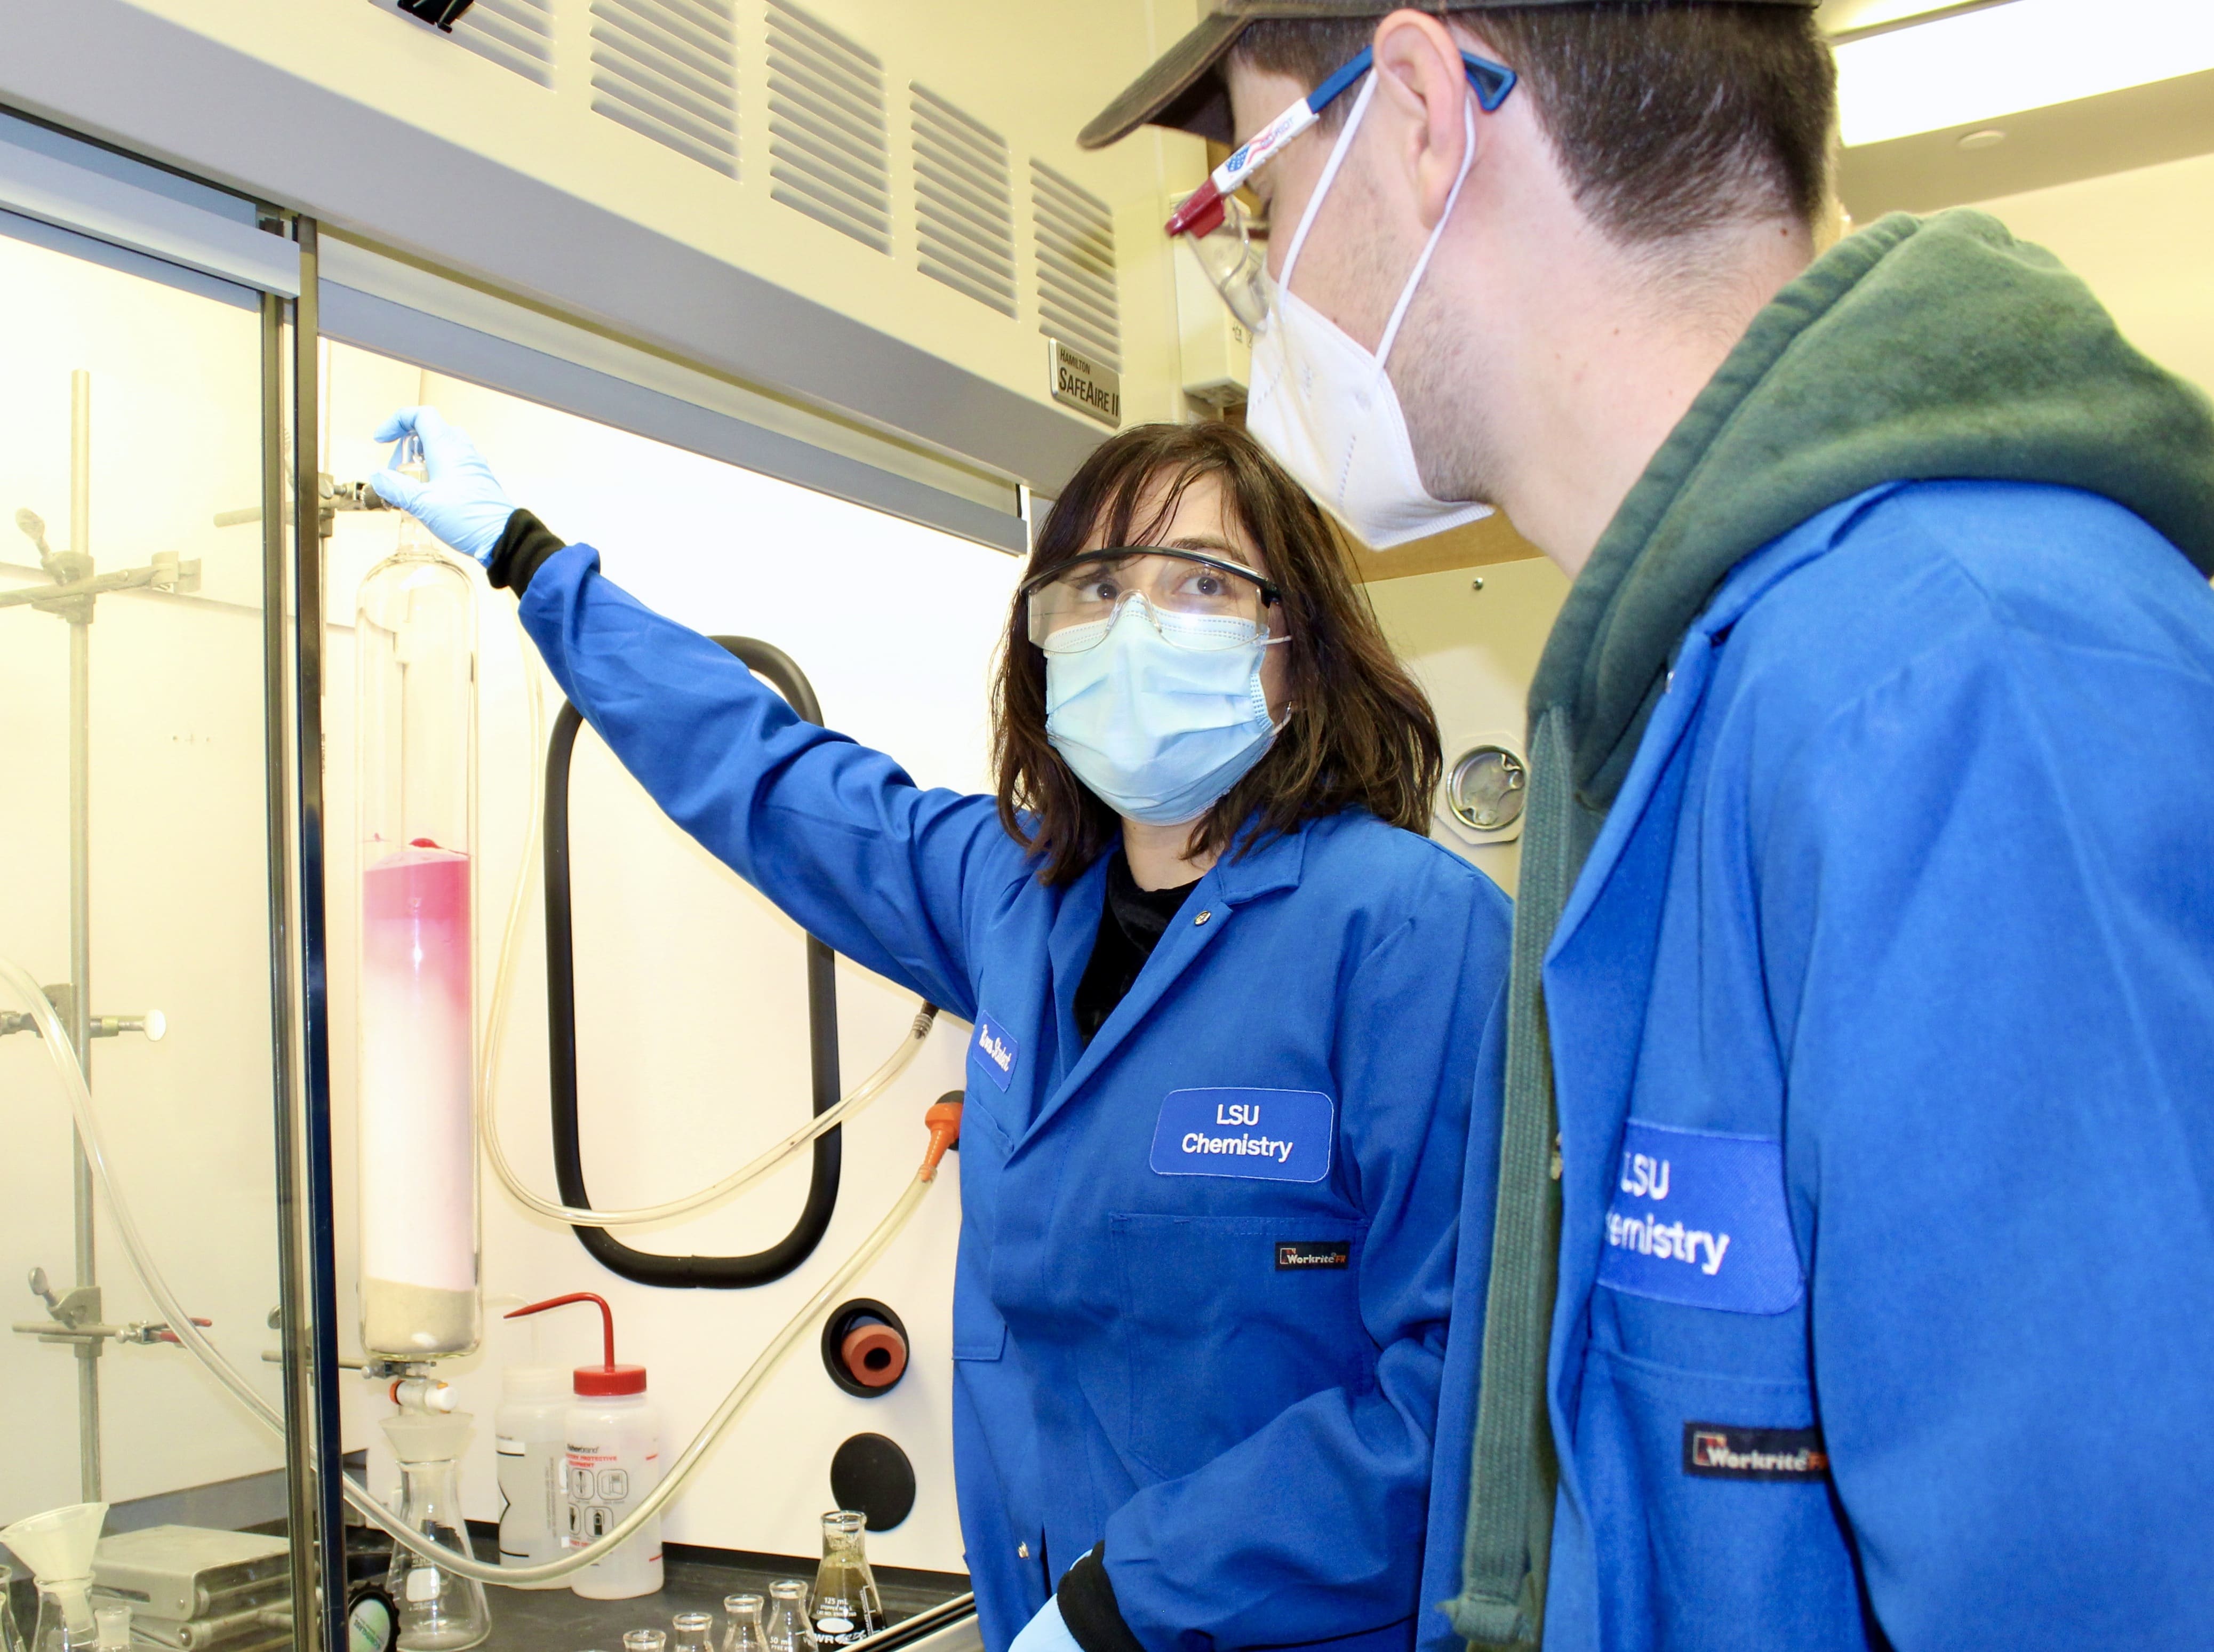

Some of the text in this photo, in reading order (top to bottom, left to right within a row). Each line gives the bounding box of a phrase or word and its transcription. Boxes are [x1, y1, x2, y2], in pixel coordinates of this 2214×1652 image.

[1060, 348, 1090, 374] HAMILTON
[1112, 393, 1119, 417] II
[1216, 1104, 1260, 1126] LSU
[1181, 1132, 1293, 1163] Chemistry
[1605, 1207, 1730, 1275] emistry
[1286, 1254, 1335, 1264] Workrite
[824, 1597, 836, 1605] 125
[770, 1636, 779, 1644] 50
[814, 1633, 834, 1643] WR
